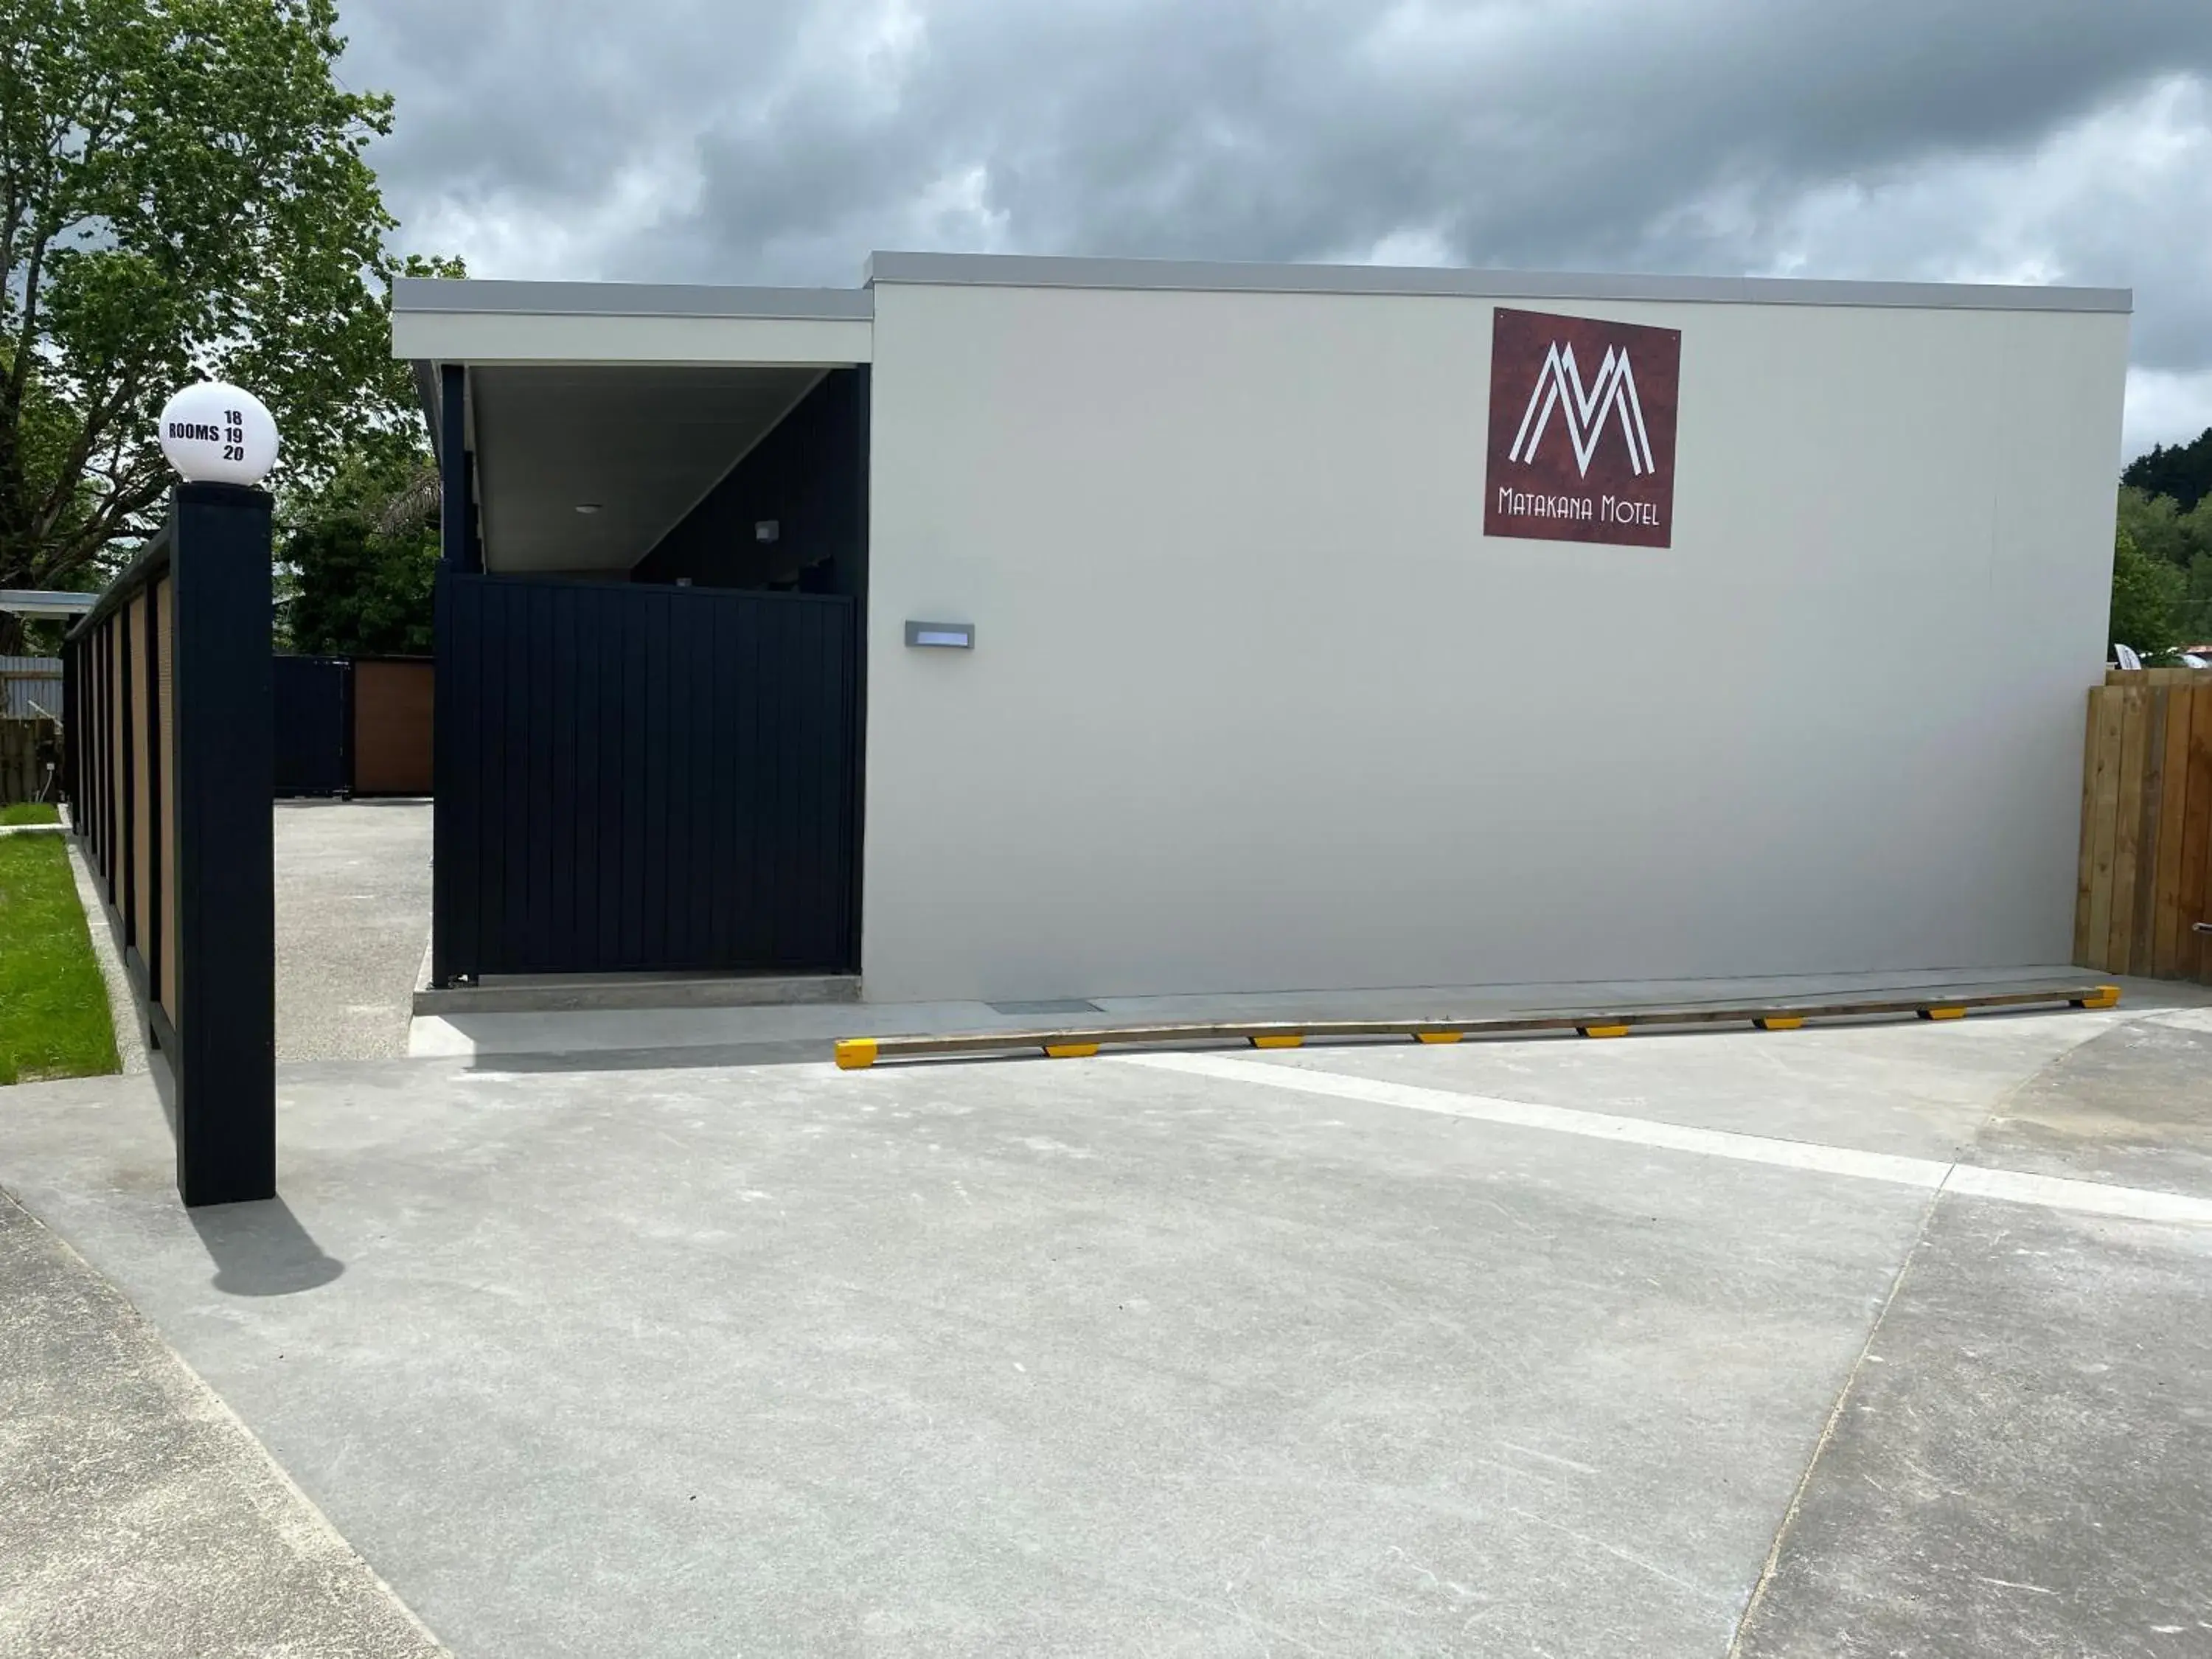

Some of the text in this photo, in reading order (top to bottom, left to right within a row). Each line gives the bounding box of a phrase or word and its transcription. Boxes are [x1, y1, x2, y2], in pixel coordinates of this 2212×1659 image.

[223, 409, 243, 425] 18
[169, 422, 243, 444] ROOMS 19
[223, 445, 244, 462] 20
